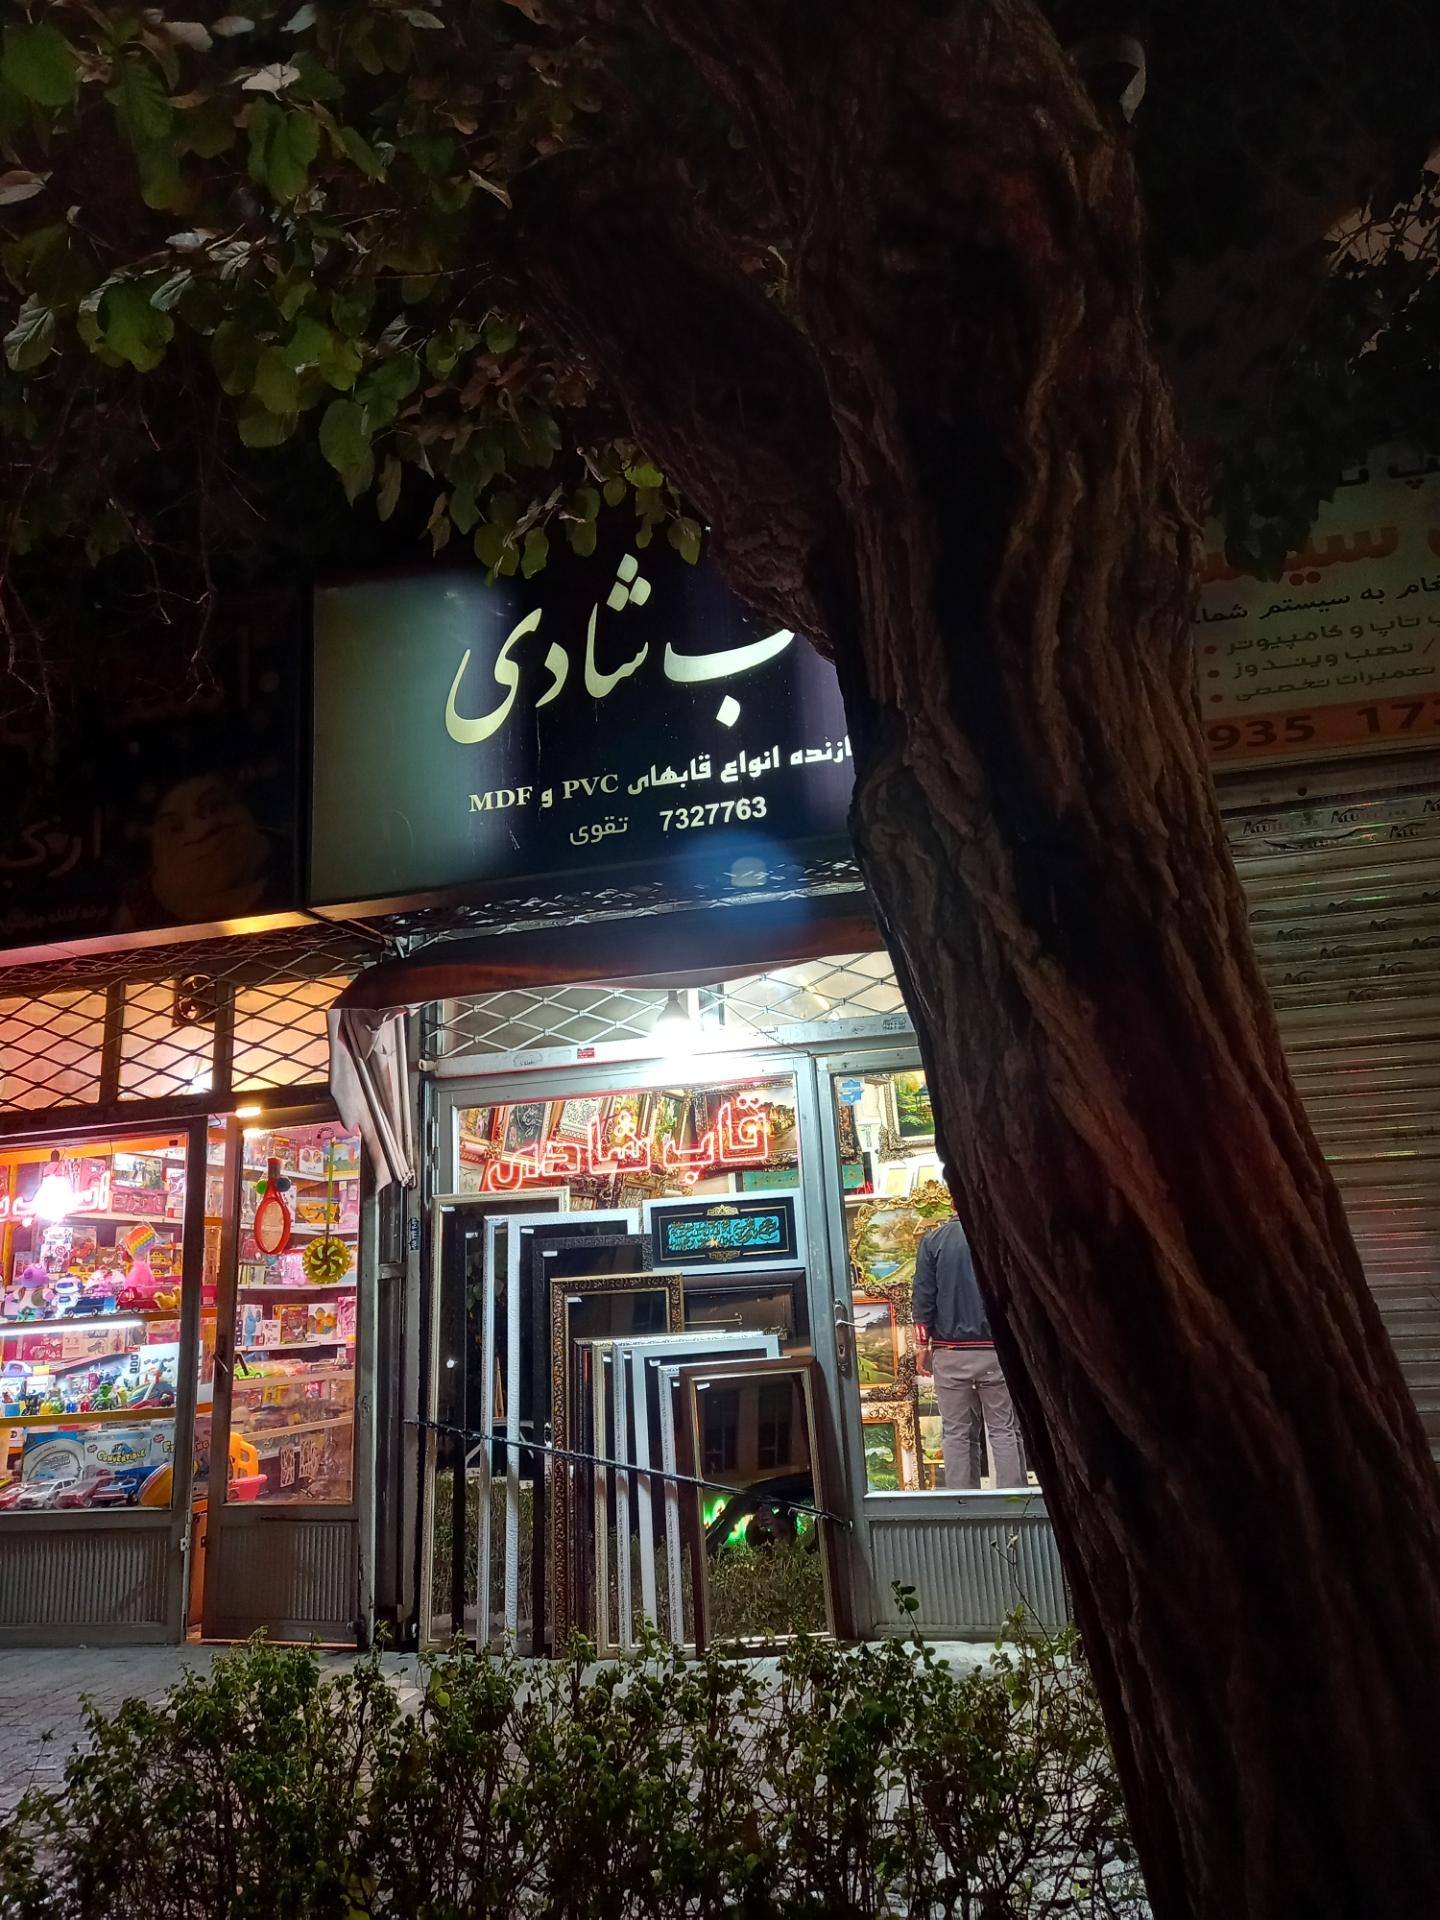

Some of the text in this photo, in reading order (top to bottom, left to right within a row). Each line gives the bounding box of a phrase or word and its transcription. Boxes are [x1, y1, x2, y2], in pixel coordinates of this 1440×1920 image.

[1259, 595, 1350, 620] سیستم
[1360, 588, 1385, 604] به
[1226, 624, 1343, 655] کامپیوتر
[1350, 624, 1364, 639] و
[1370, 616, 1421, 636] تاپ
[445, 553, 651, 744] شادی
[1345, 642, 1413, 663] نصب
[1234, 653, 1338, 679] ویندوز
[1235, 666, 1435, 702] تعمیرات تخصصی
[468, 734, 853, 812] ازنده انواع قابهای PVC و MDF
[659, 796, 768, 831] 7327763
[569, 814, 629, 846] تقوی
[488, 1094, 769, 1192] قاب شادی
